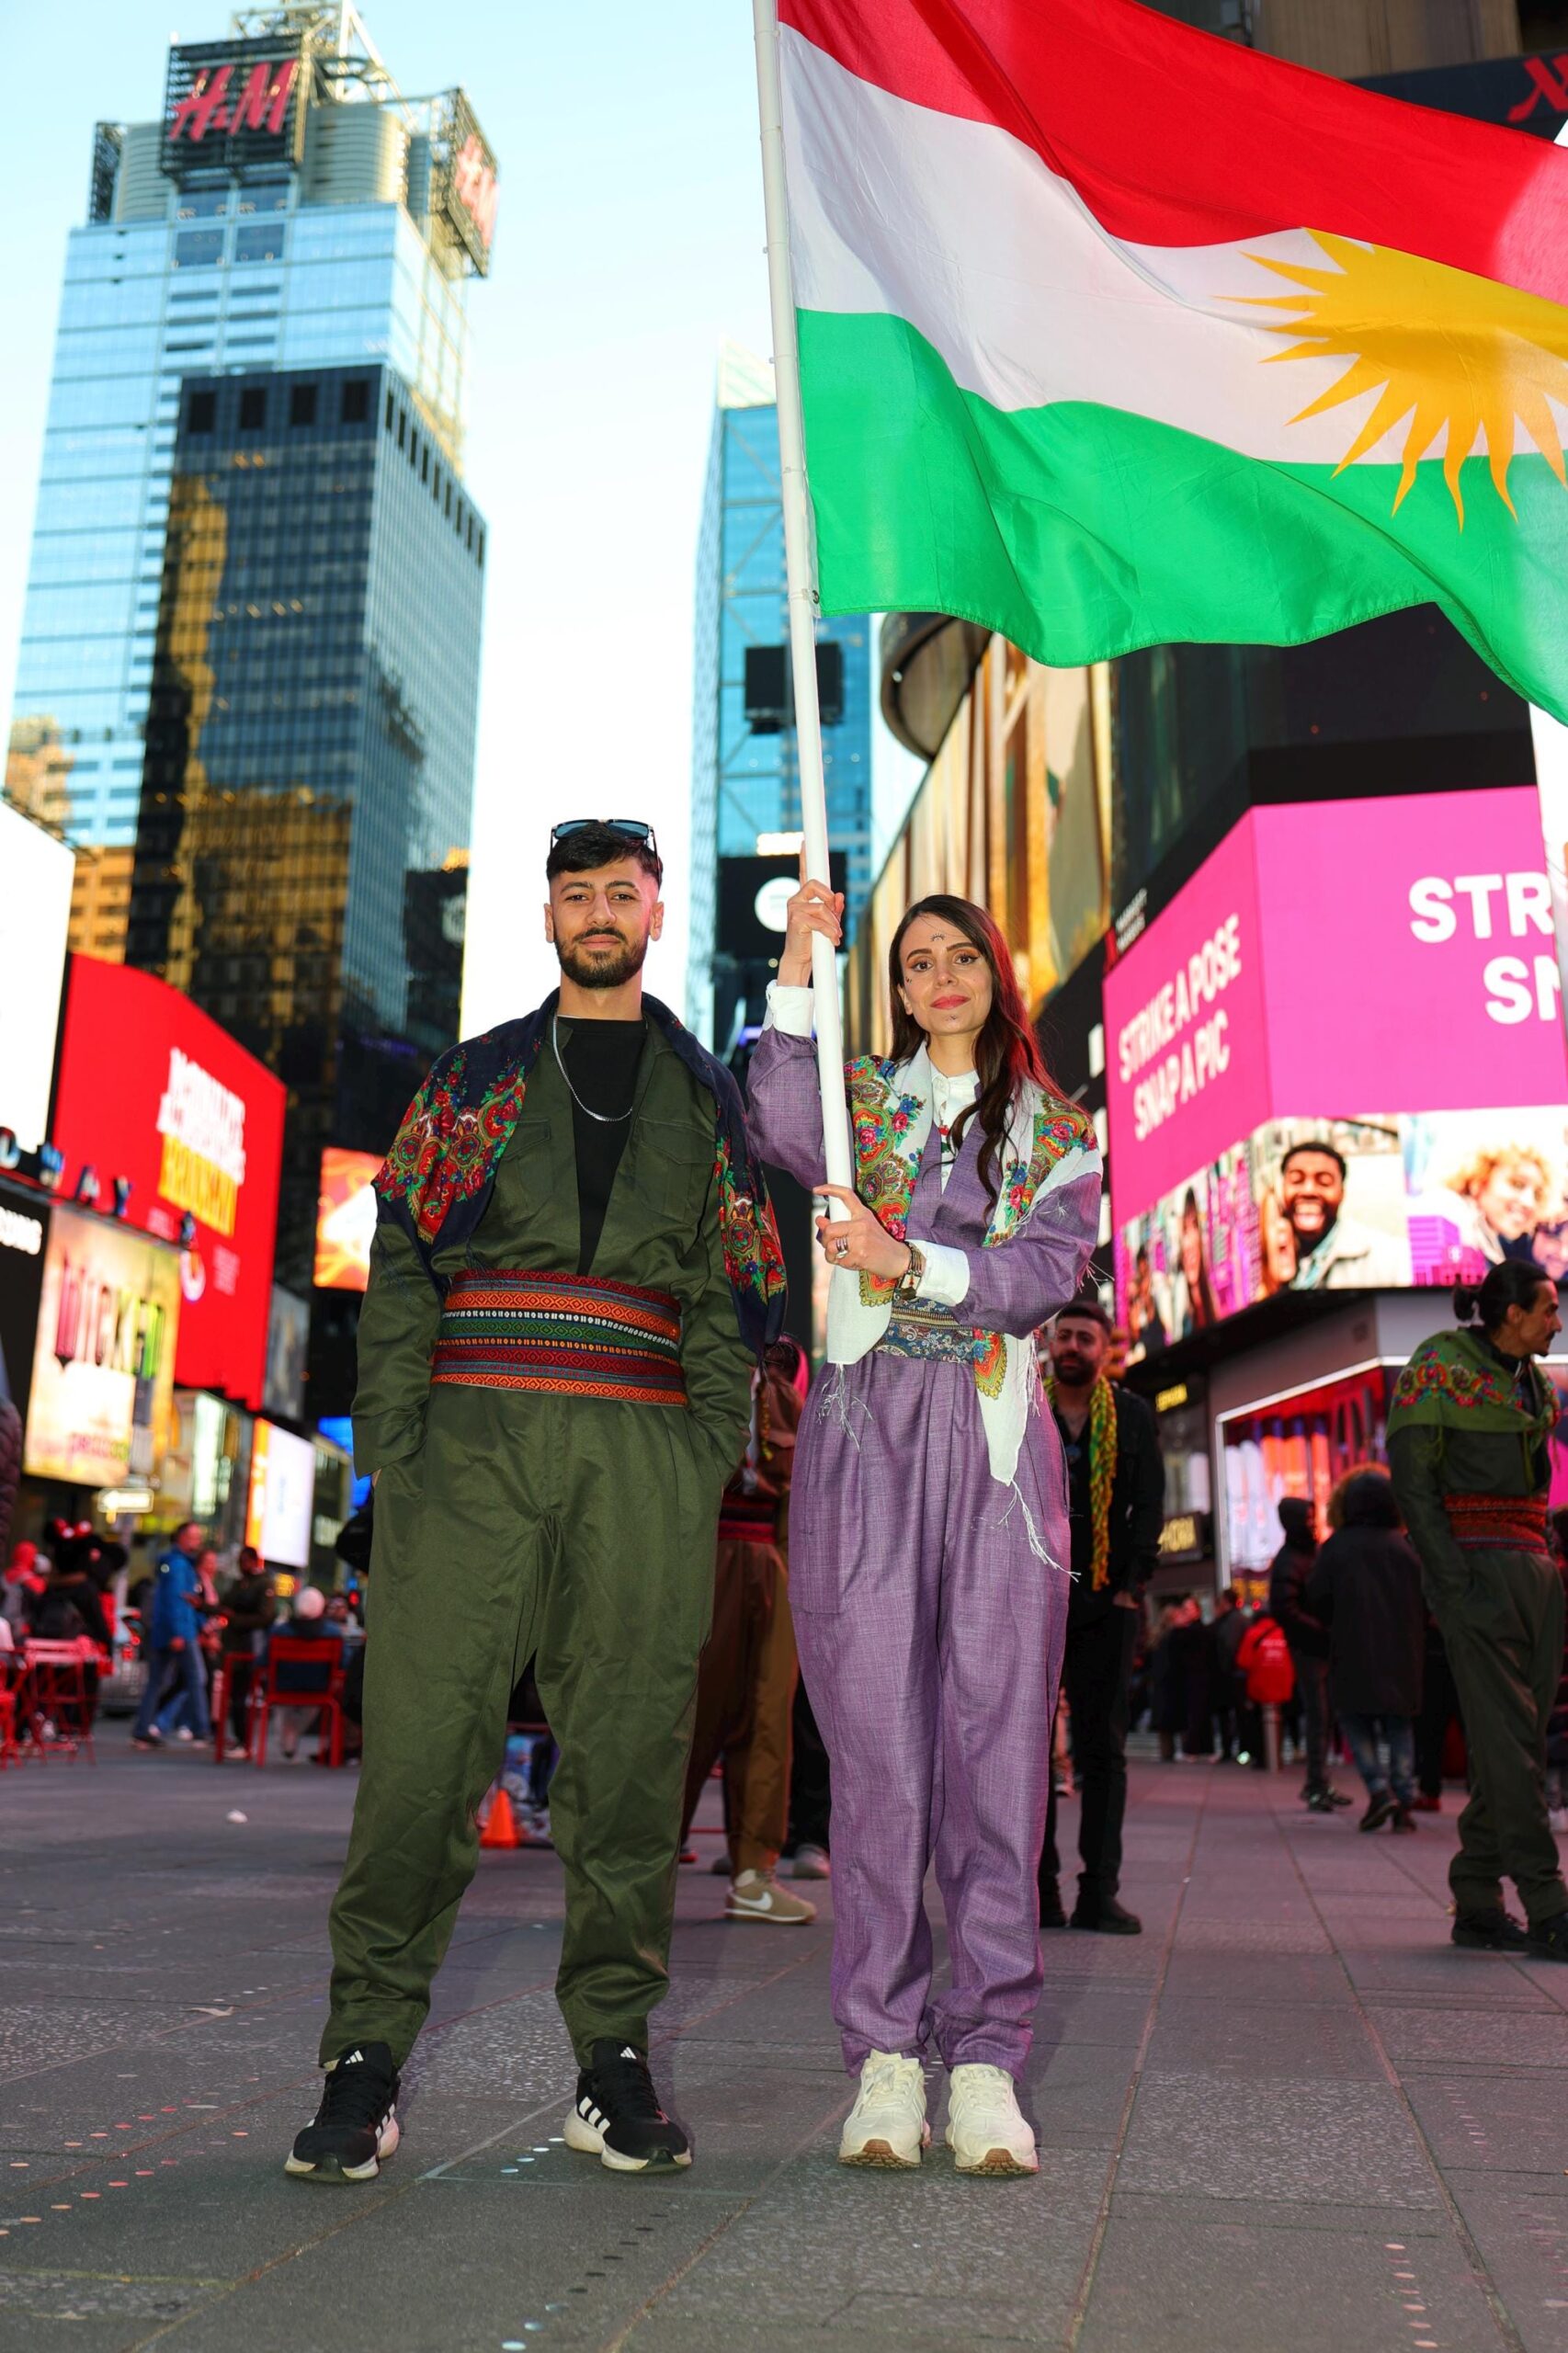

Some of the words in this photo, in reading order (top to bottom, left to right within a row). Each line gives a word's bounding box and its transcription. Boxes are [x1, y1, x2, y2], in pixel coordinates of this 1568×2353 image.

[169, 59, 299, 142] H&M
[1409, 871, 1555, 943] STR
[1119, 982, 1176, 1085] STRIKE
[1174, 970, 1191, 1032] A
[1188, 913, 1242, 1017] POSE
[1133, 1054, 1180, 1142] SNAP
[1180, 1042, 1198, 1105] A
[1195, 1009, 1230, 1091] PIC
